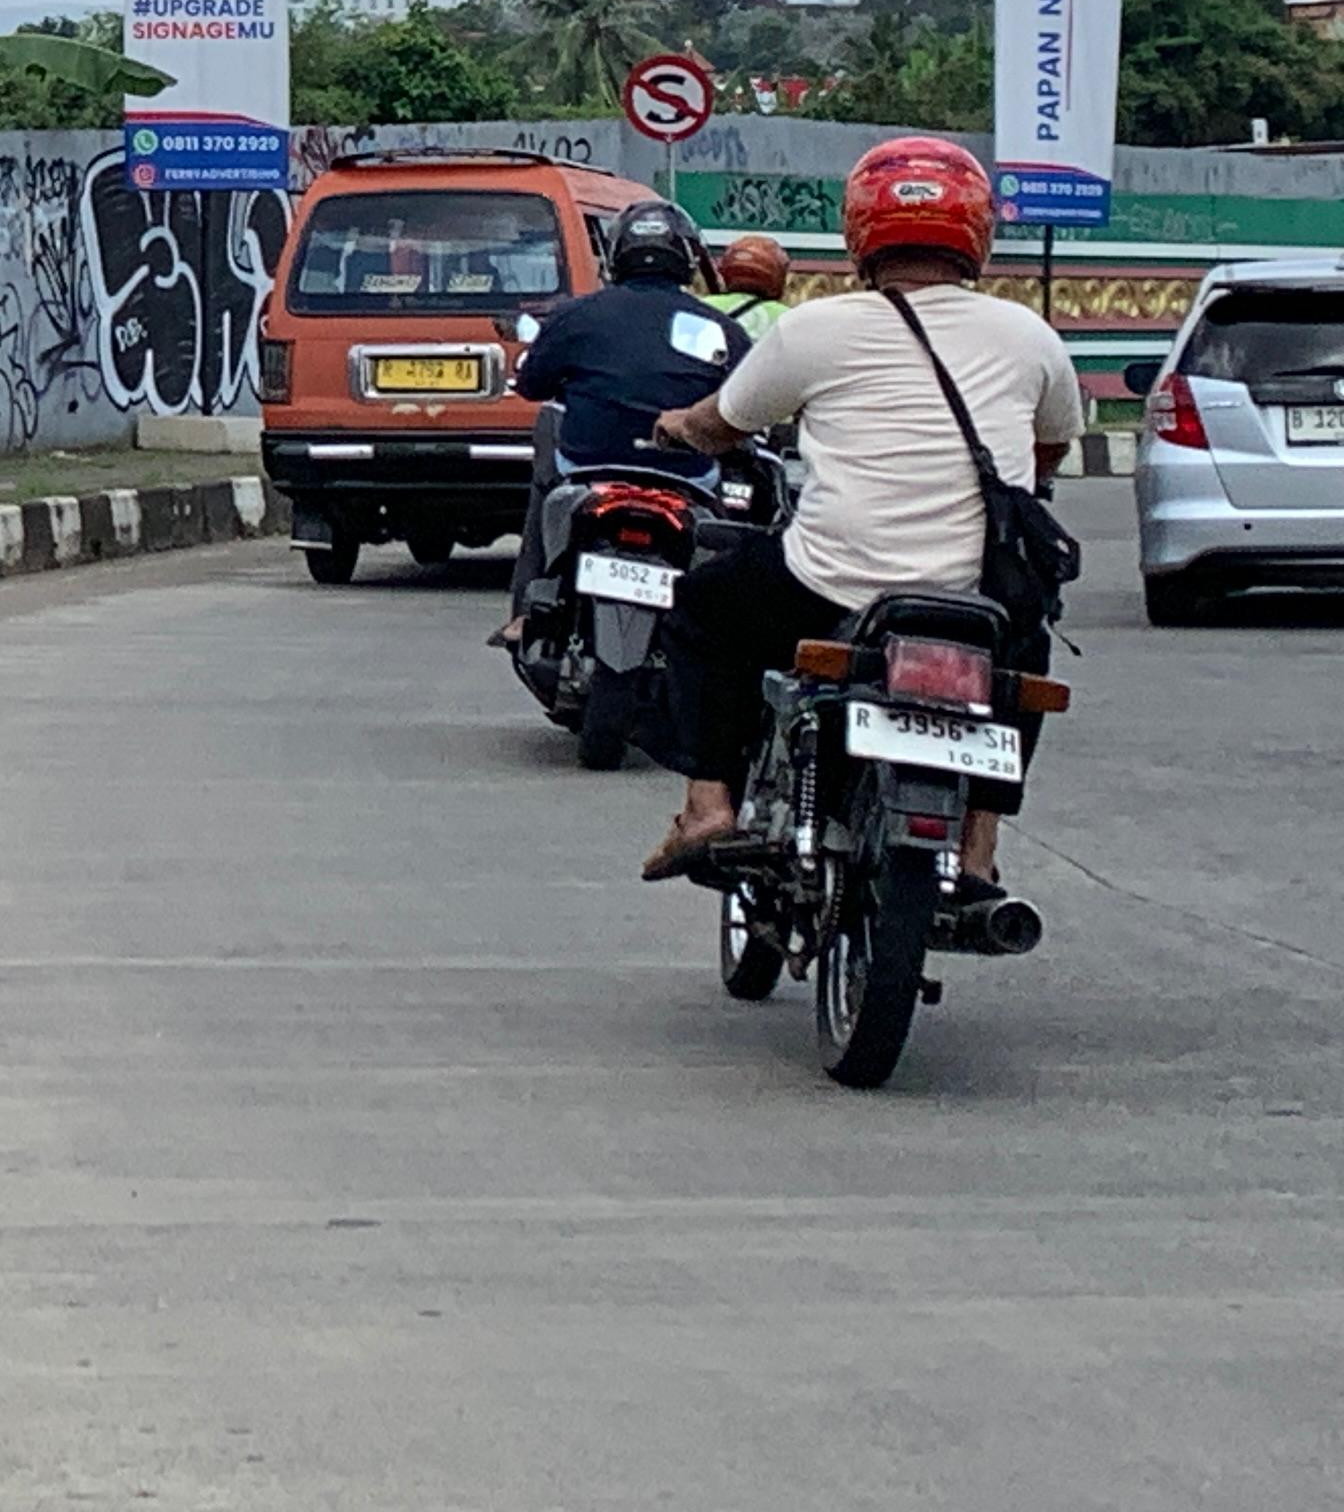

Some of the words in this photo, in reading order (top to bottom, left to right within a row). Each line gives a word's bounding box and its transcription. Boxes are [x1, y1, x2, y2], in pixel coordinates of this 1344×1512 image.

[132, 21, 275, 40] SIGNAGEMU
[1037, 30, 1061, 141] PAPAN
[163, 135, 200, 152] 0811
[202, 135, 236, 152] 370
[238, 135, 280, 152] 2929
[609, 561, 651, 585] 5052
[855, 707, 870, 728] R
[983, 727, 1016, 753] SH
